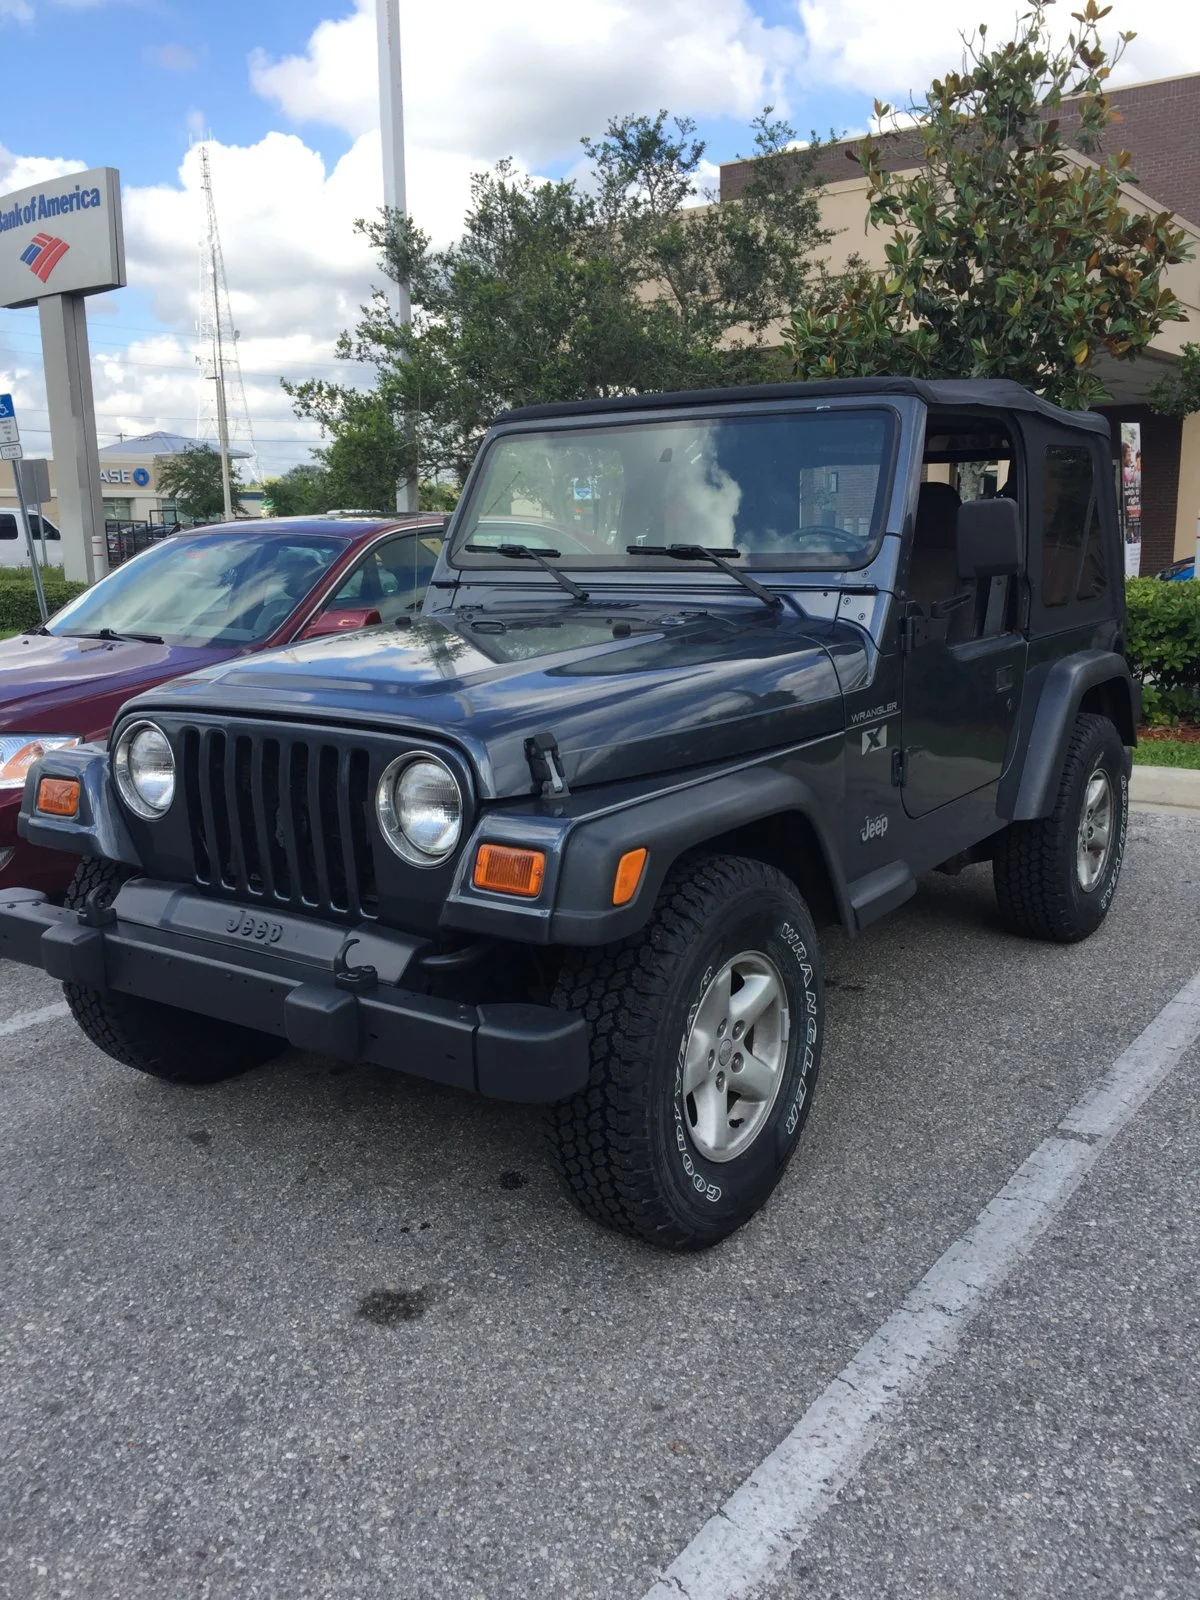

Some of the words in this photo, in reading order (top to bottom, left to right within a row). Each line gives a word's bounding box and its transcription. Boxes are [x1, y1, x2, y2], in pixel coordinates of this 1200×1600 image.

[23, 196, 37, 224] of
[38, 185, 101, 220] America
[100, 468, 131, 484] ASE
[850, 701, 898, 724] WRANGLER
[861, 724, 887, 756] X
[860, 813, 889, 842] Jeep
[226, 909, 284, 946] Jeep
[780, 922, 817, 1136] WRANGLER
